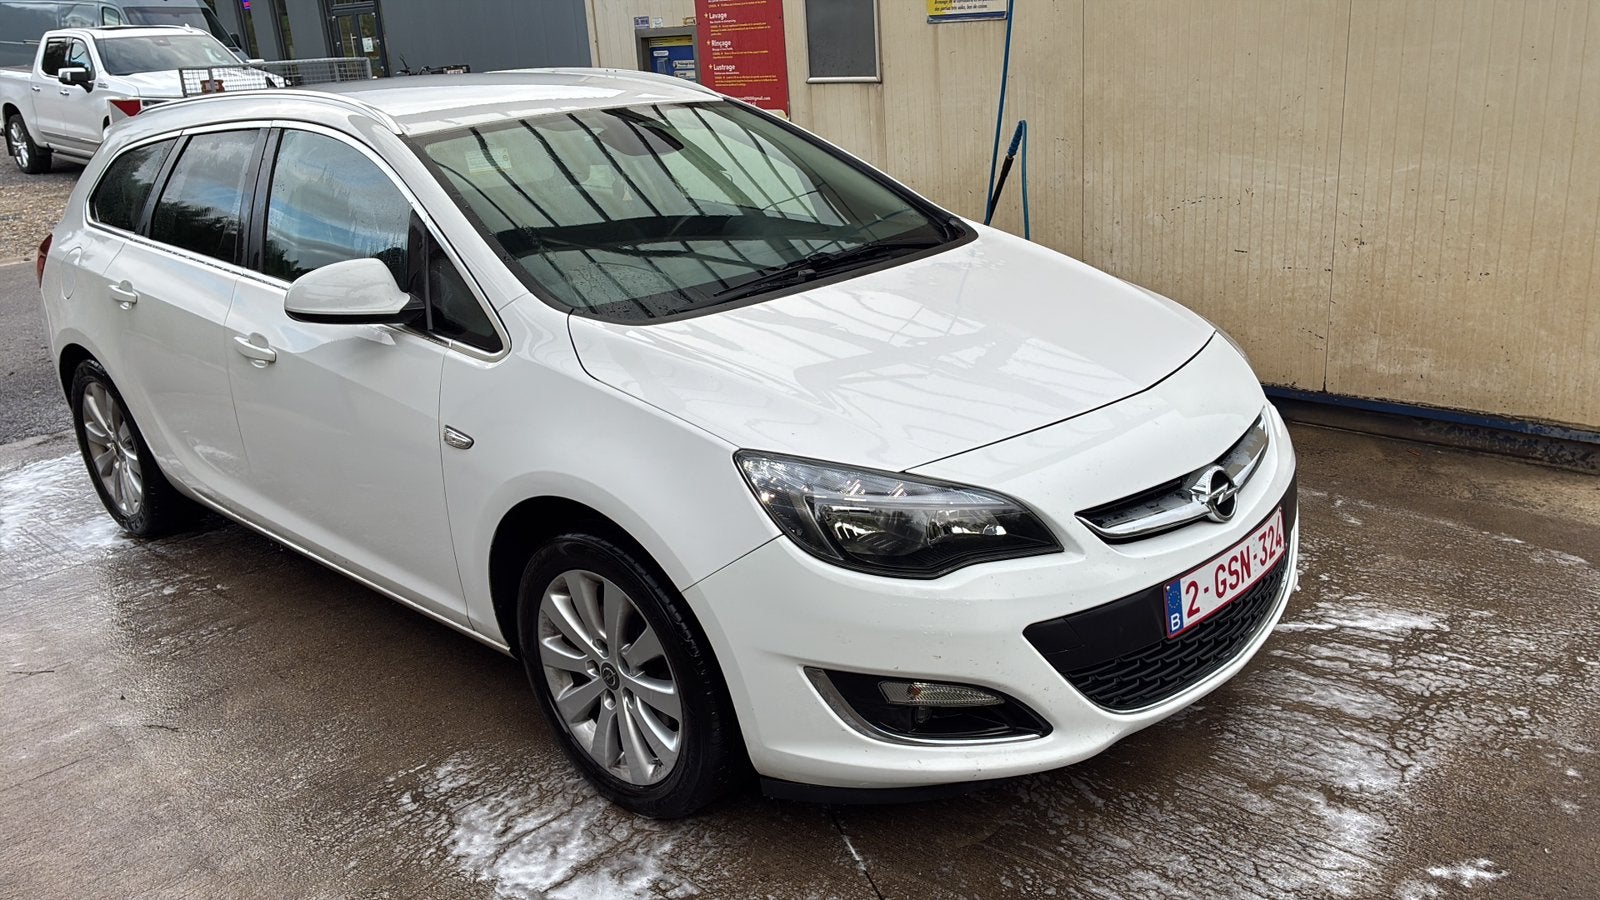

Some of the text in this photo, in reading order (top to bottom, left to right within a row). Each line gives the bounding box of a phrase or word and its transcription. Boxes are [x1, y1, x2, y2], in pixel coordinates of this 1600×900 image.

[711, 40, 732, 48] Rinçage
[713, 64, 736, 72] Lustrage
[1185, 515, 1283, 619] 2-GSN-324
[1170, 612, 1181, 631] B
